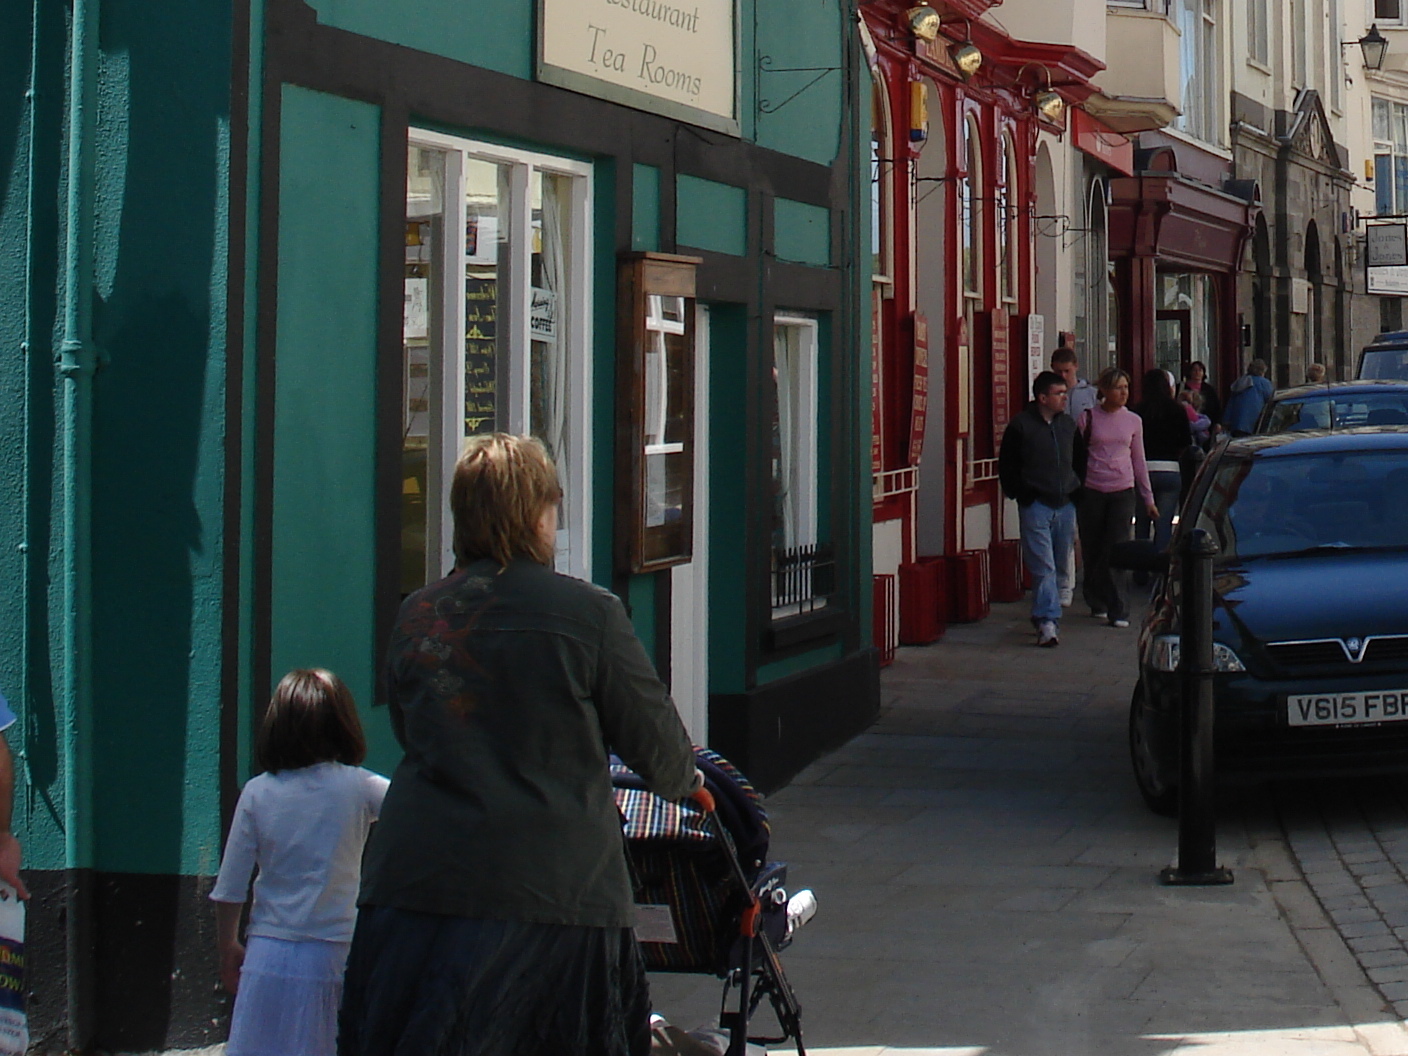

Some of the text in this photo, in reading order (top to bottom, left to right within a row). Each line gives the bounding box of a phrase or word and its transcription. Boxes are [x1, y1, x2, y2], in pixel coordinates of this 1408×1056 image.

[587, 23, 702, 97] Tea Rooms
[1371, 227, 1403, 244] Jones
[1372, 246, 1403, 261] Jones
[1297, 696, 1357, 722] V615
